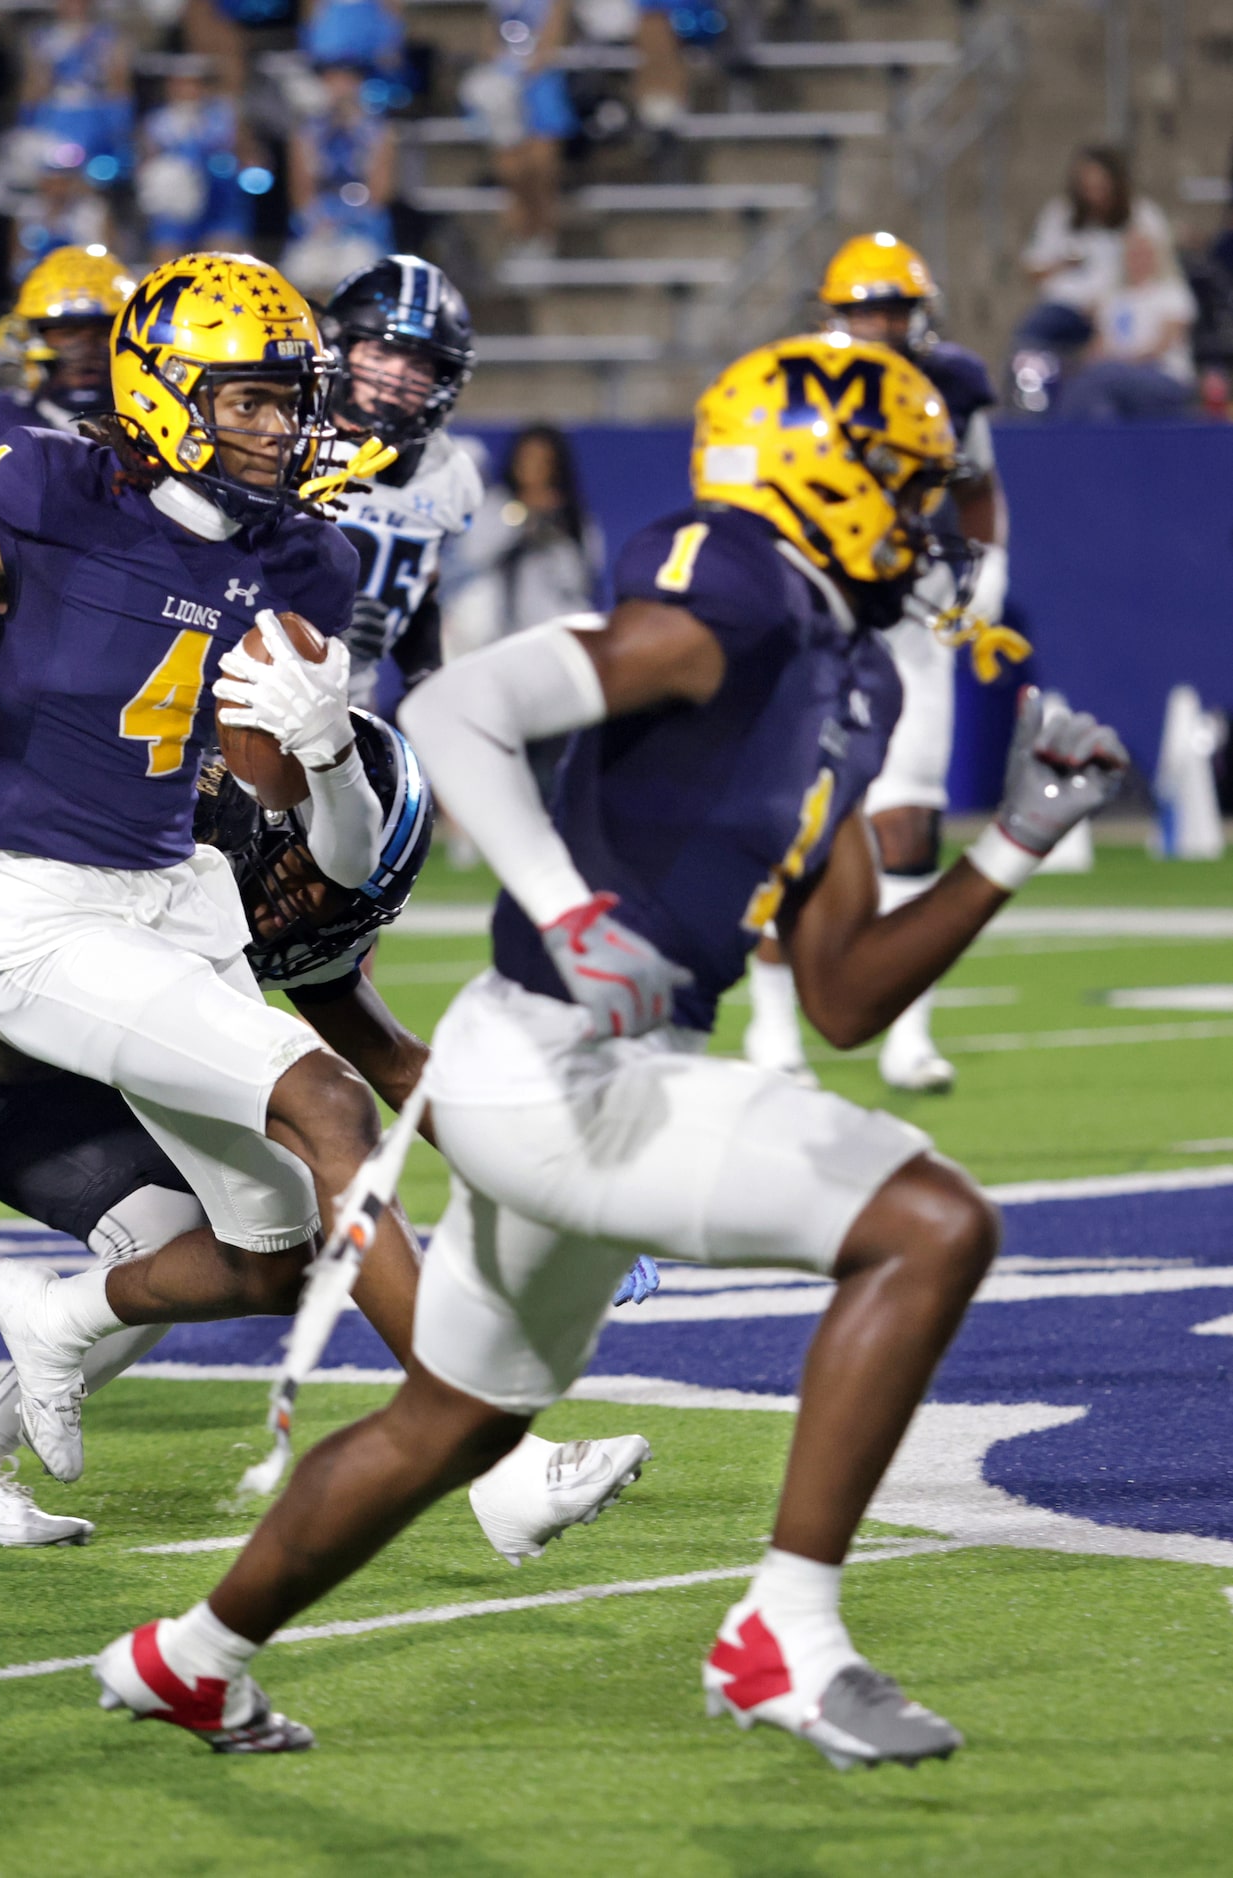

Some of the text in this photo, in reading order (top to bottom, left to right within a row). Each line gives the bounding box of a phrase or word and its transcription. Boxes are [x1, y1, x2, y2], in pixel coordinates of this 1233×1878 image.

[116, 276, 198, 356] M
[276, 340, 306, 356] GRIT
[778, 355, 887, 431] M
[654, 521, 710, 593] 1
[161, 596, 222, 630] LIONS
[119, 629, 214, 777] 4
